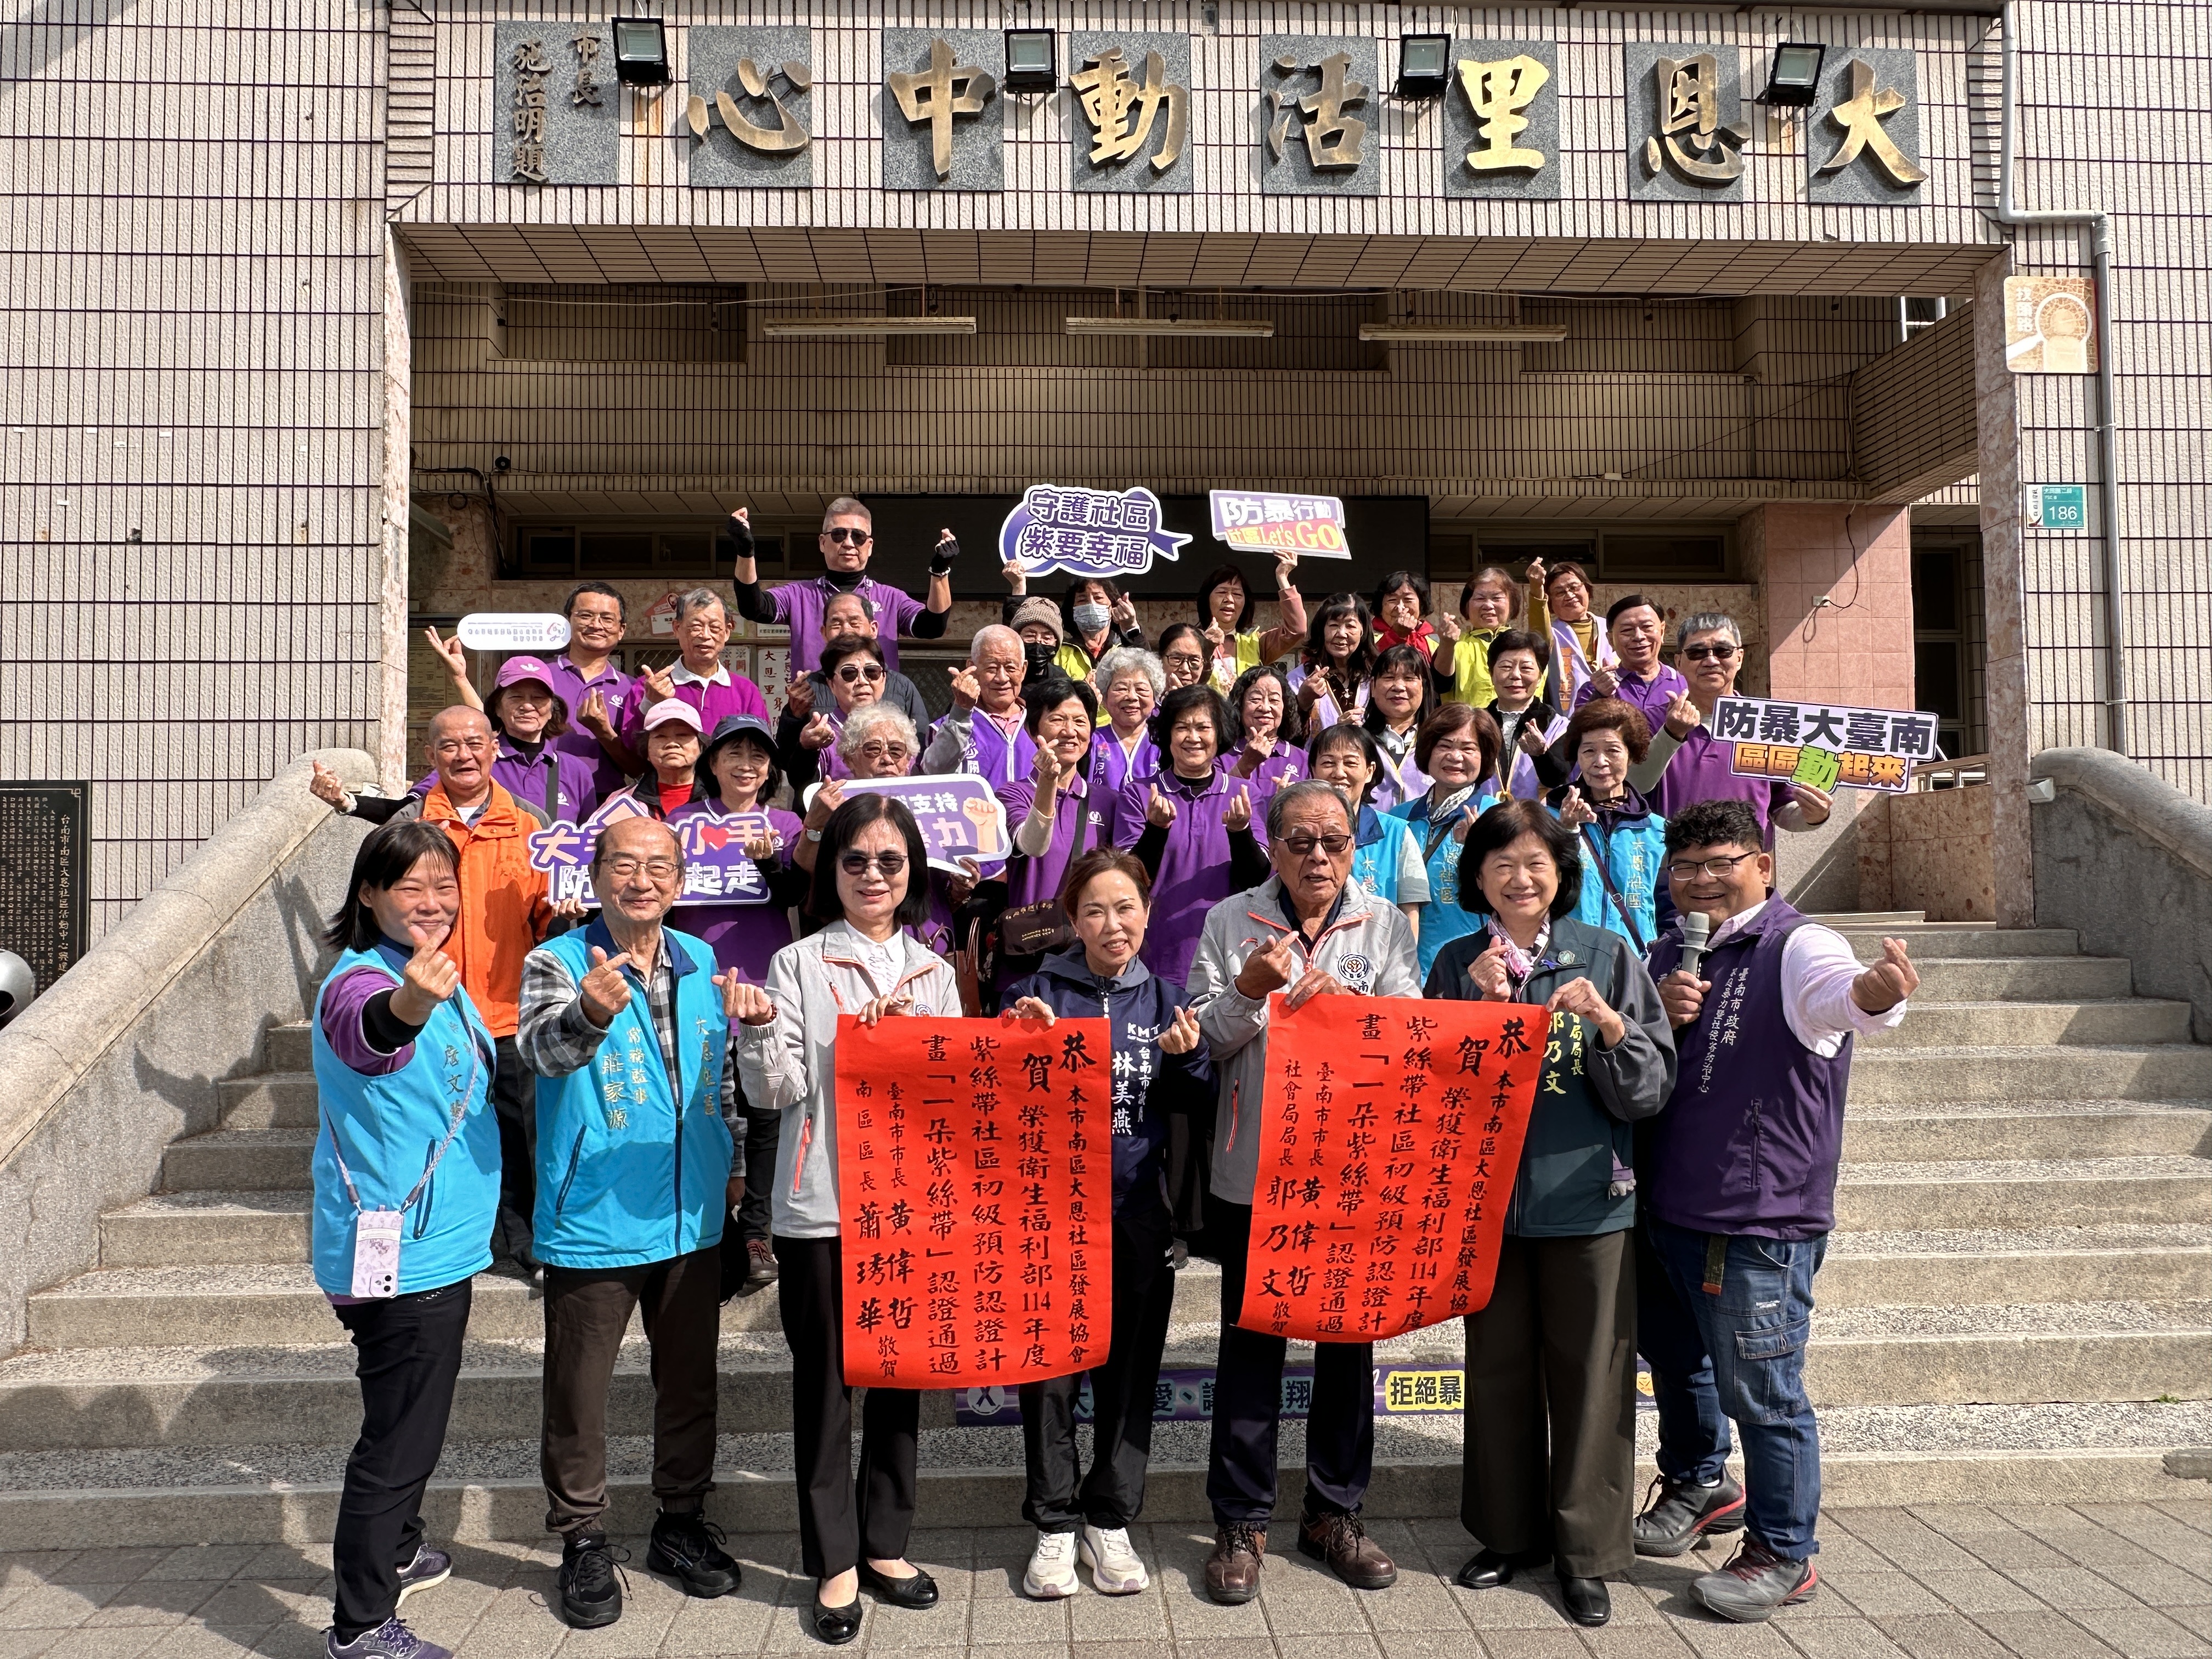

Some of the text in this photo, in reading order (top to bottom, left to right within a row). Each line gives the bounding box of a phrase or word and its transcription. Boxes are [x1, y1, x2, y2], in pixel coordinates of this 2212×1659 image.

[572, 27, 602, 108] 市長
[686, 37, 1928, 188] 大恩里活動中心
[1025, 527, 1146, 565] 紫要幸福
[1031, 493, 1151, 530] 守護社區
[1218, 496, 1332, 527] 防暴行動
[1296, 521, 1341, 549] GO
[2049, 506, 2078, 520] 186
[1716, 701, 1933, 755] 防暴大臺南
[1734, 742, 1906, 791] 區區動起來
[1127, 1022, 1161, 1039] KMT
[1111, 1051, 1138, 1136] 林美燕
[968, 1035, 1007, 1373] 紫絲帶社區初級預防認證計
[1358, 1015, 1438, 1333] 紫絲帶社區初級預防認證計
[1398, 1086, 1472, 1330] 榮獲衛生福利部114年度
[885, 1198, 918, 1330] 黃偉哲
[1017, 1105, 1053, 1369] 榮獲衛生福利部114年度
[1066, 1085, 1091, 1365] 本市南區大恩社區發展協會
[1256, 1175, 1299, 1298] 郭乃文
[1285, 1175, 1327, 1298] 黃偉哲
[1390, 1375, 1462, 1406] 拒絕暴
